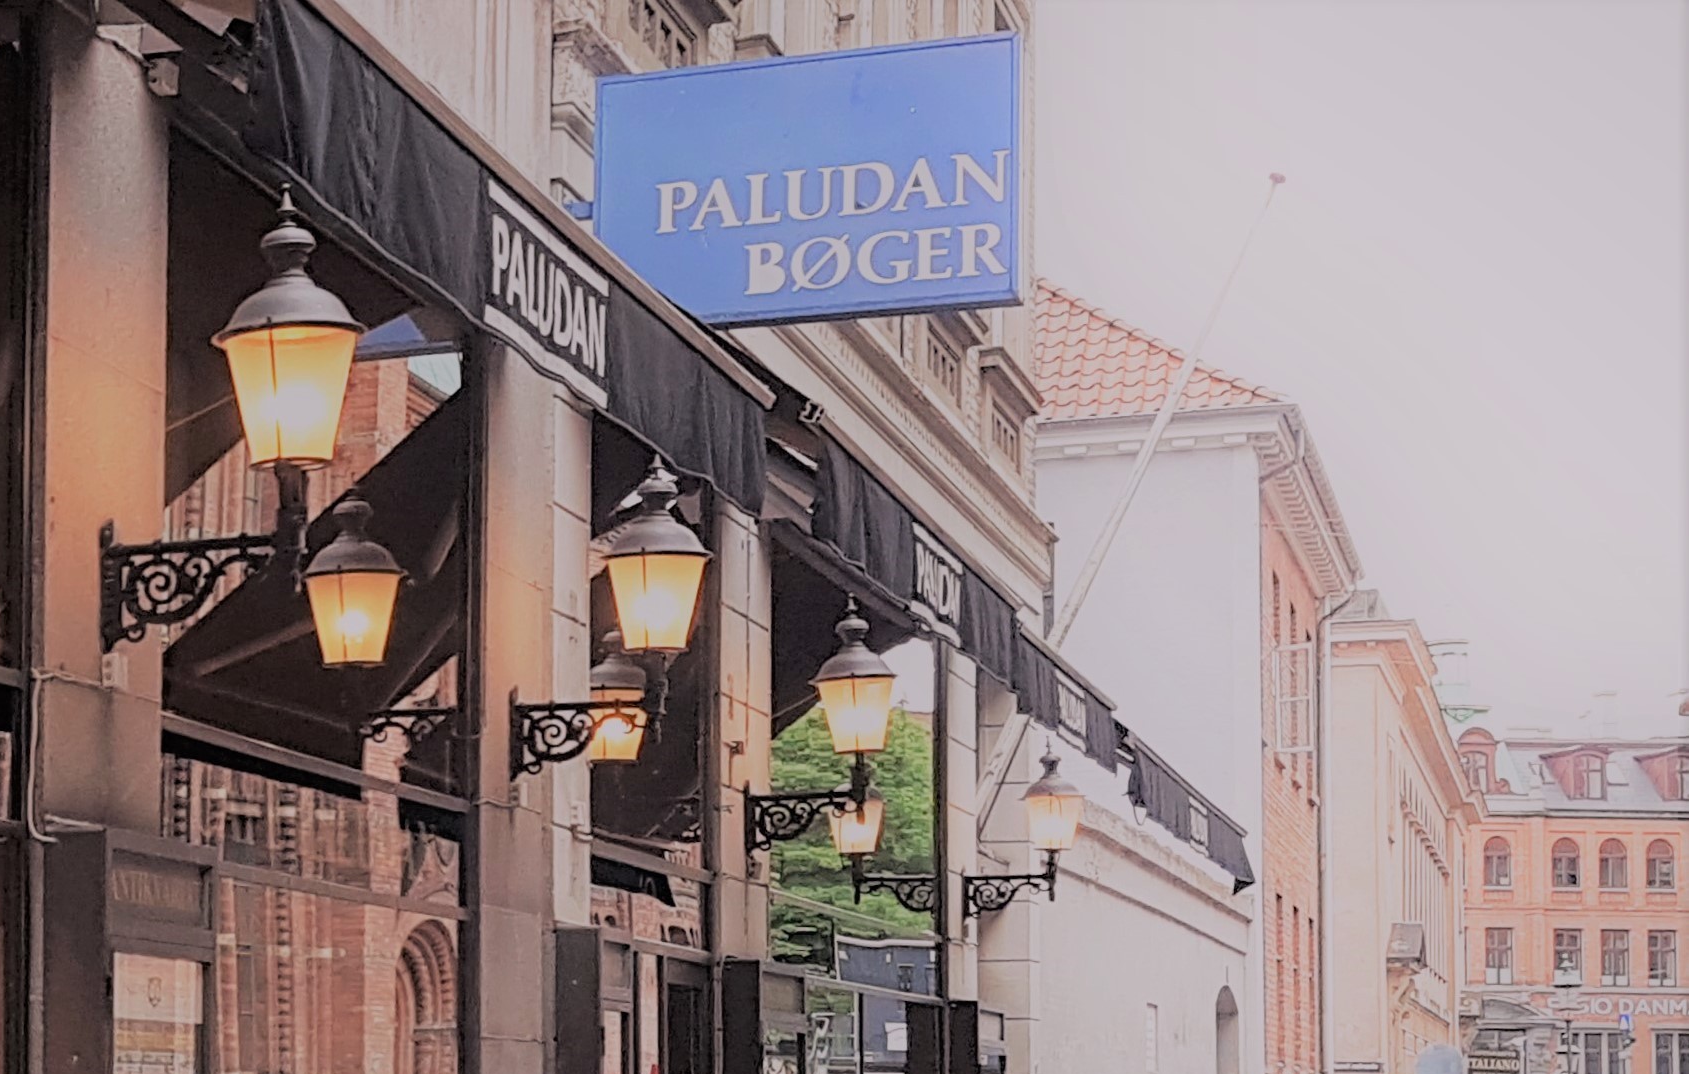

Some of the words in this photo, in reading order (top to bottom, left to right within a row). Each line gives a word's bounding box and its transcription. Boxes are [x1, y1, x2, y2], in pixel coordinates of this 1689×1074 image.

[655, 149, 1009, 234] PALUDAN
[492, 213, 606, 378] PALUDAN
[744, 222, 1007, 296] BØGER
[1618, 998, 1689, 1016] DANM
